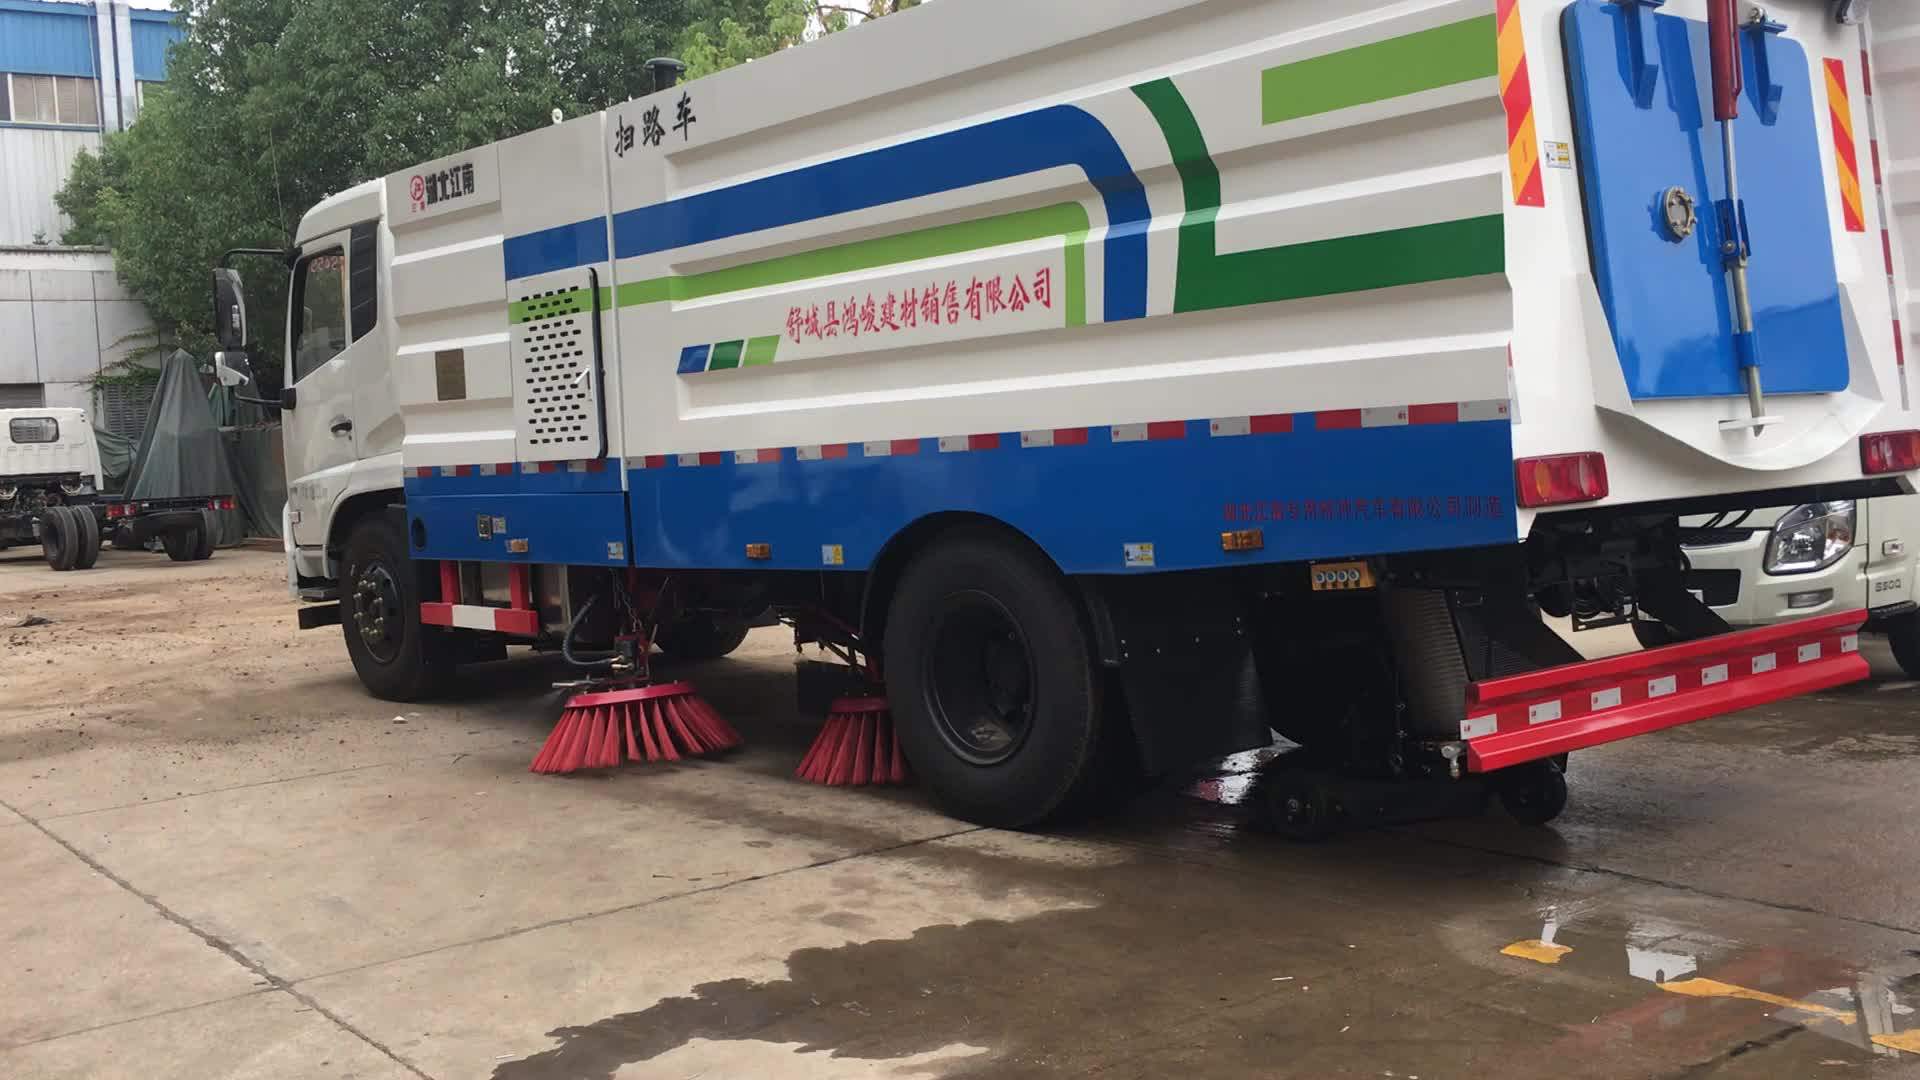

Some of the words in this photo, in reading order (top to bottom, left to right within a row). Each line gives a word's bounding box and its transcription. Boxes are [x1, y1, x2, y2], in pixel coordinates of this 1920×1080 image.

[614, 93, 696, 158] 扫路车
[425, 164, 475, 205] 湖北江南
[785, 267, 1052, 344] 舒城县鸿峻建材销售有限公司
